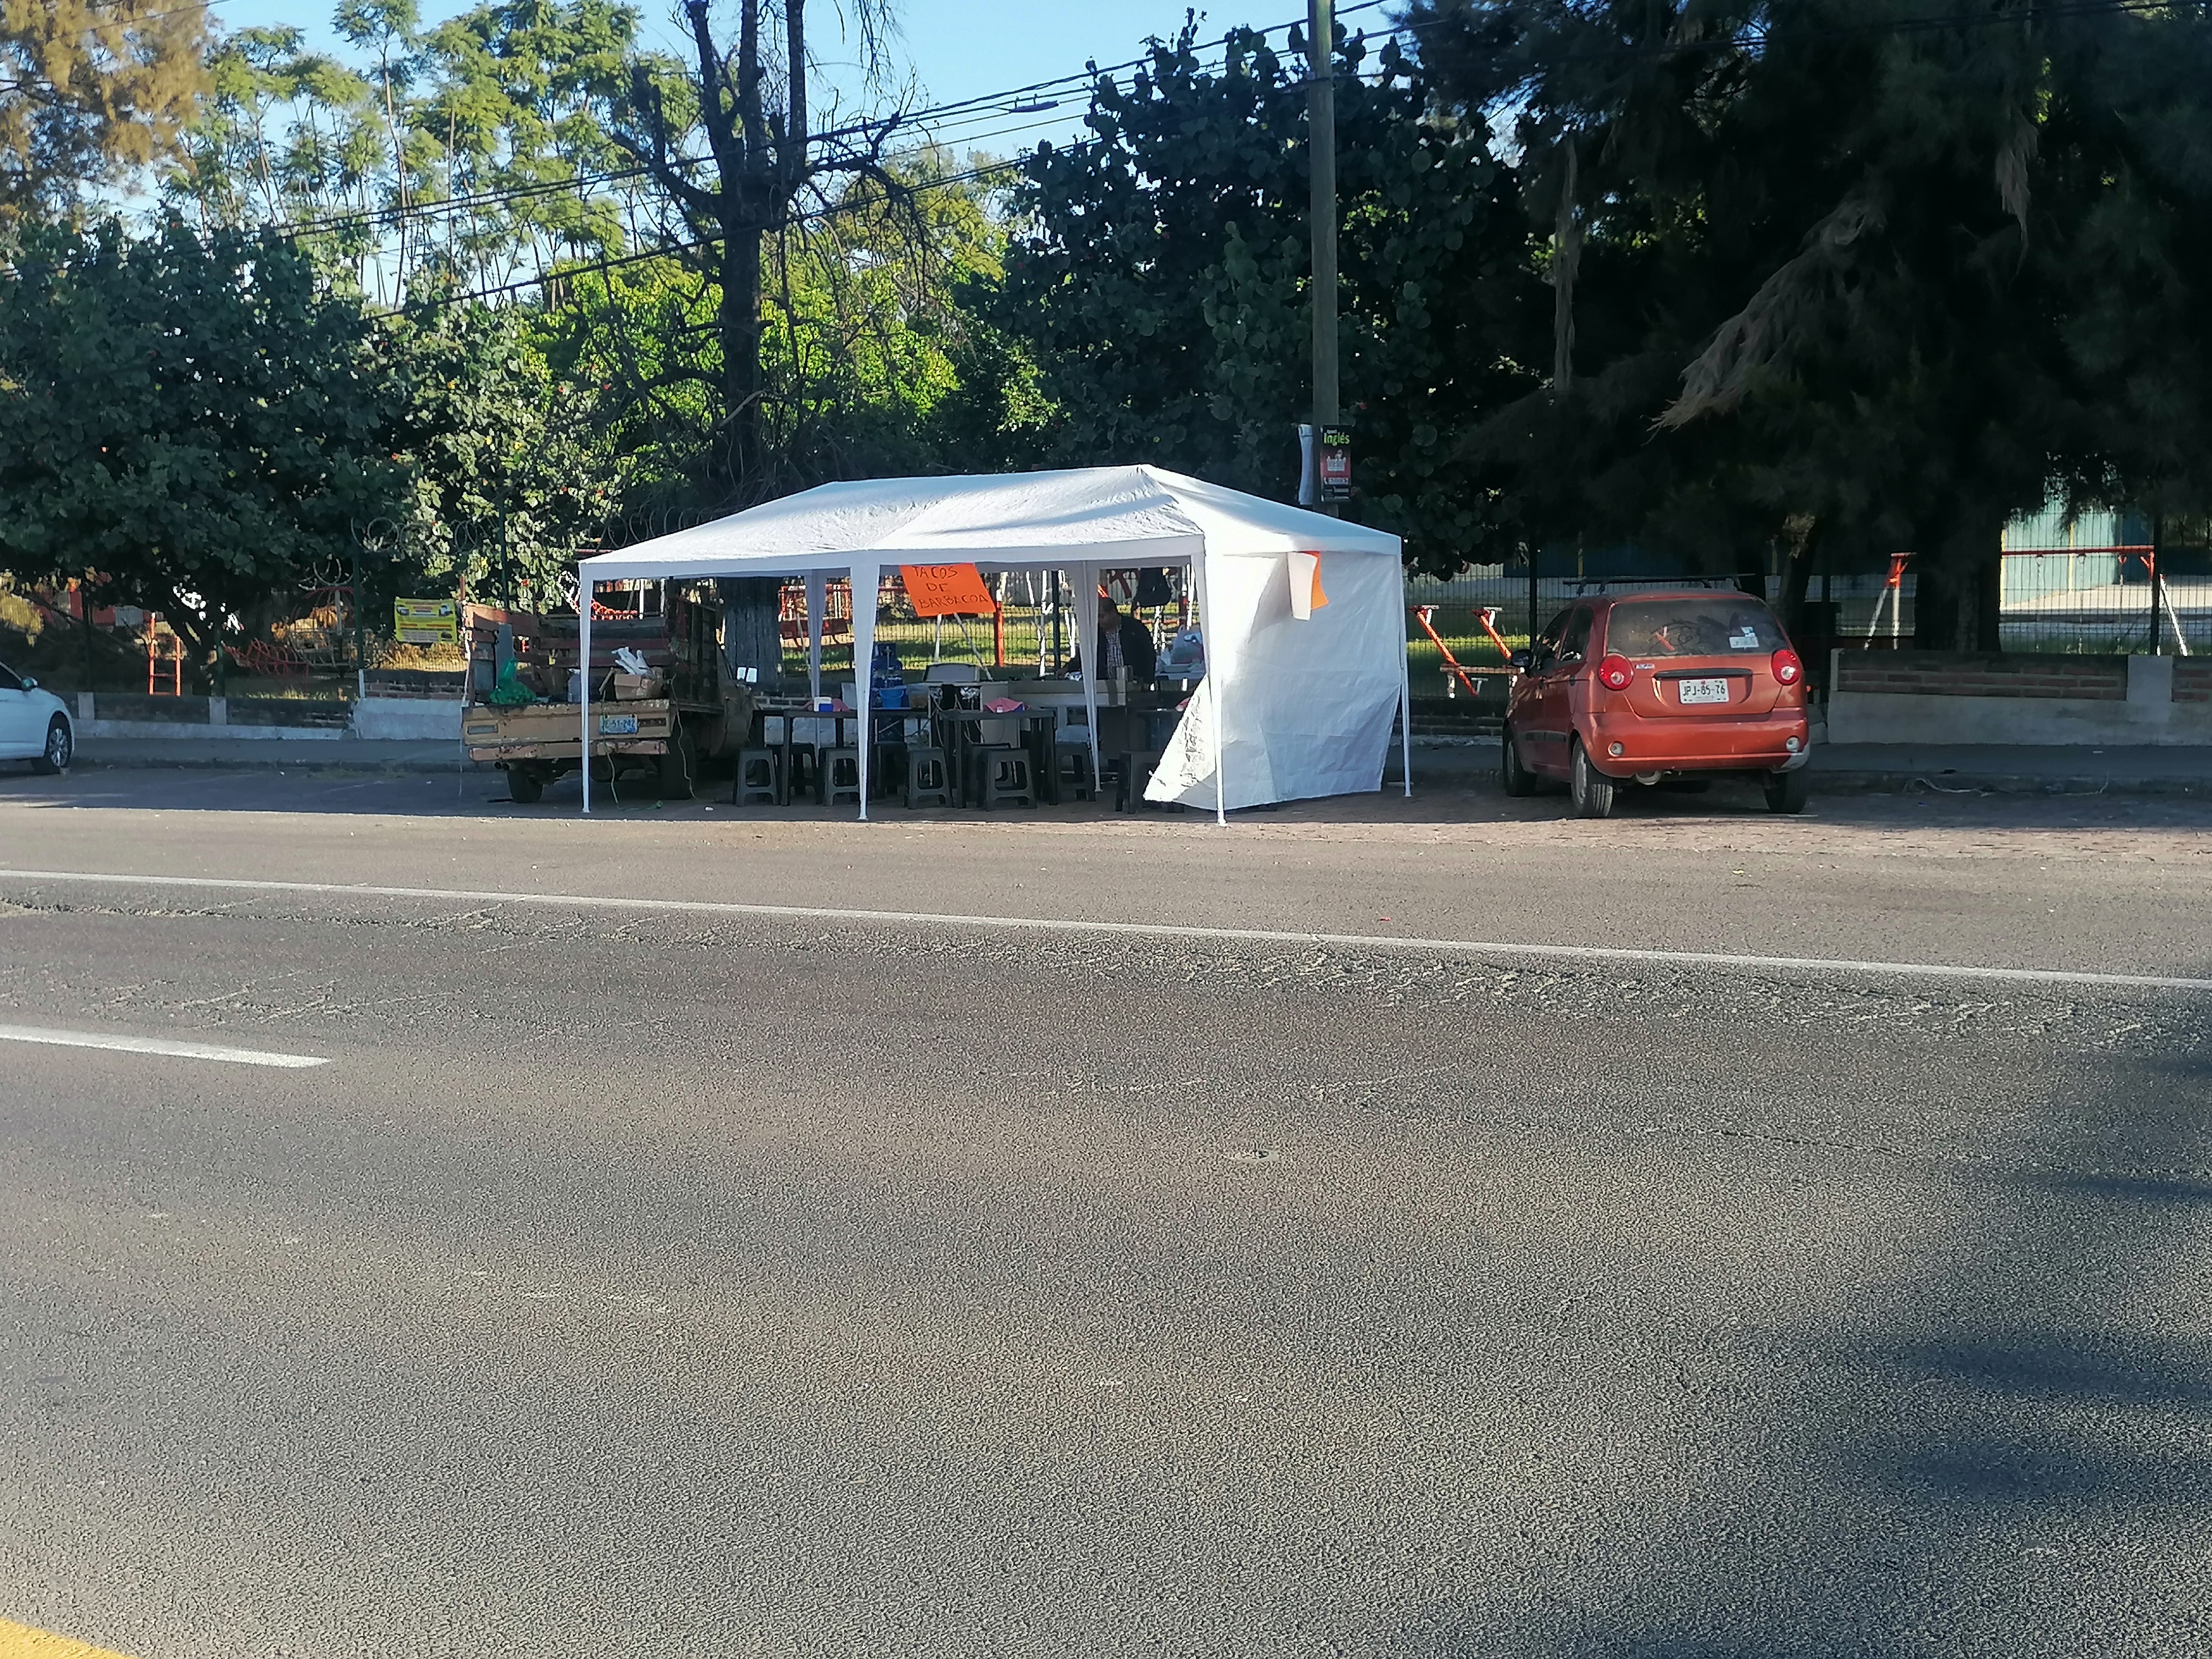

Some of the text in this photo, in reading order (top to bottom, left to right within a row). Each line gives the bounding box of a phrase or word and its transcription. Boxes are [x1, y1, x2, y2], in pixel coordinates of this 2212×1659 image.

[1324, 432, 1350, 446] Inglés
[912, 566, 958, 579] TACOS
[926, 583, 949, 592] DE
[918, 594, 989, 609] BARBACOA
[1683, 685, 1725, 696] JPJ-85-76
